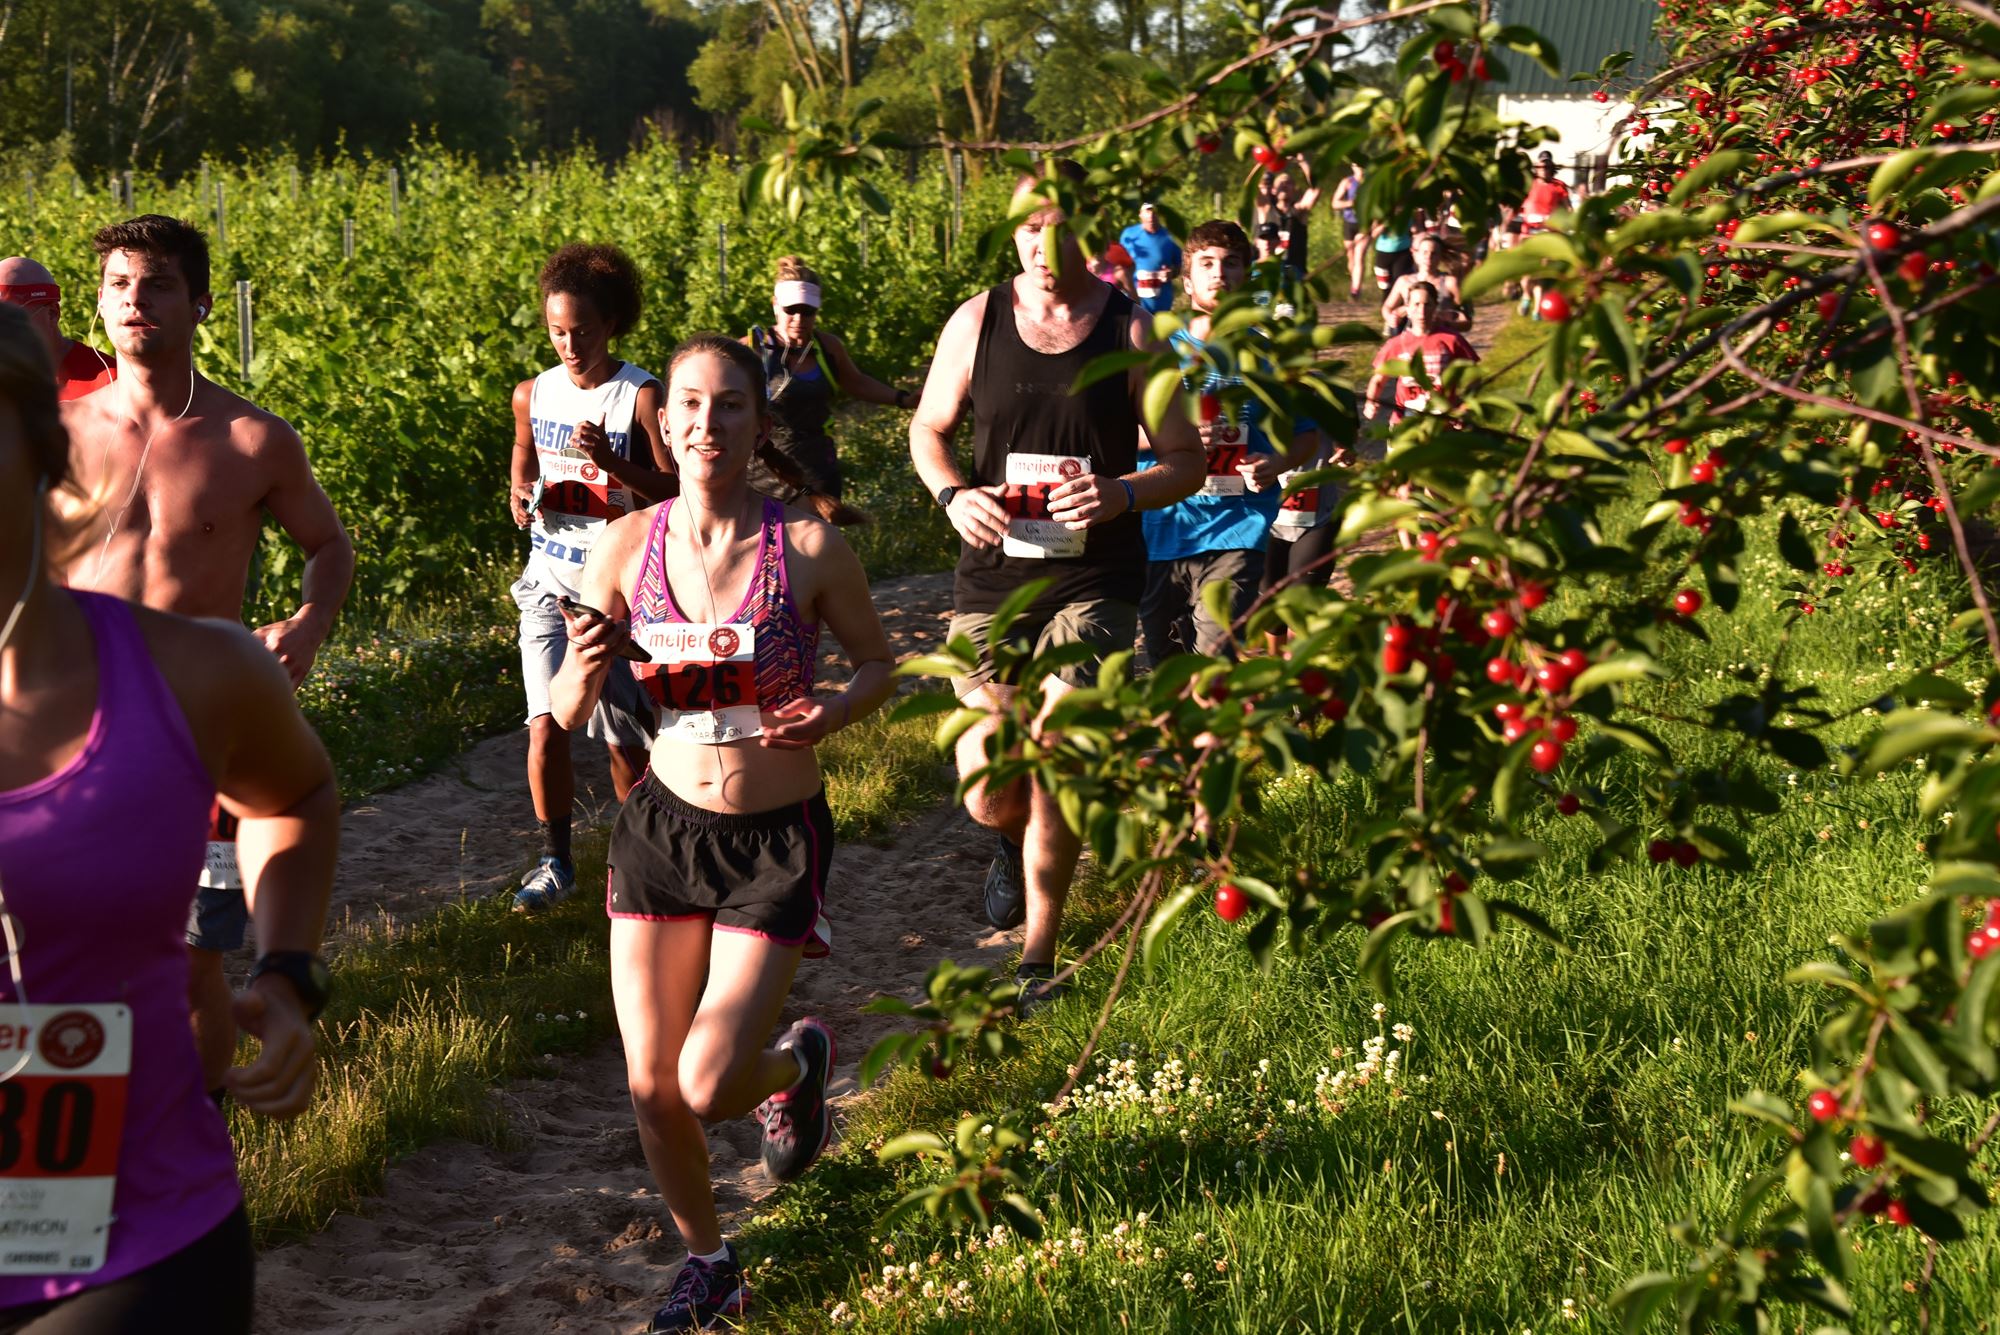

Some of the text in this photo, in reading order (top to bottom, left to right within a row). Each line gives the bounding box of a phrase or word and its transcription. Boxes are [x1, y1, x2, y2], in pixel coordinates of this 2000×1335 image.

[1015, 484, 1054, 518] 11
[649, 629, 705, 652] meijer
[654, 663, 741, 709] 126
